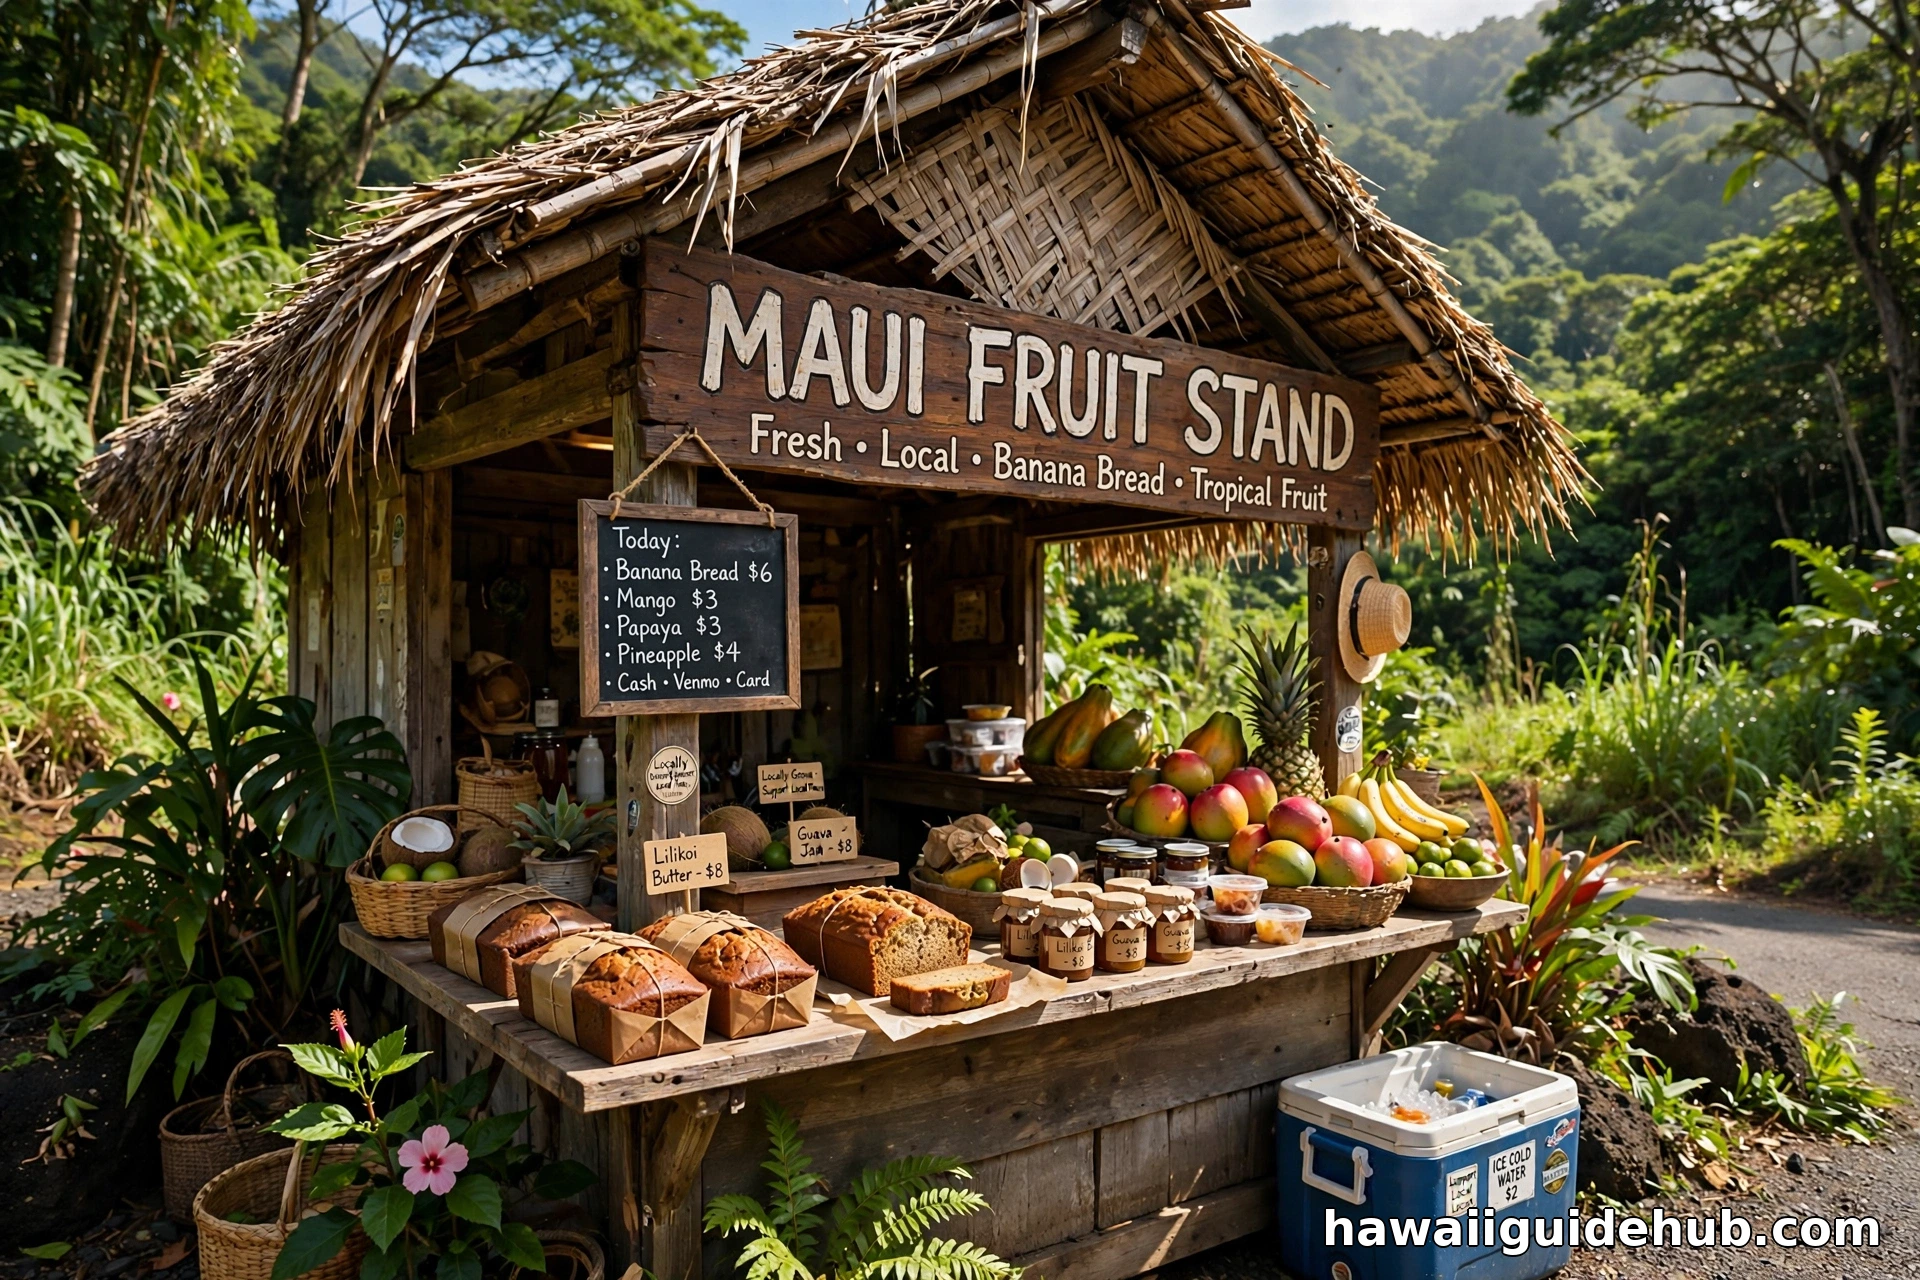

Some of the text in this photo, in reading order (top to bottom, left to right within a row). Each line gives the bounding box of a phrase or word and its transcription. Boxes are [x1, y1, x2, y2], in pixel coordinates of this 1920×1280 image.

[702, 282, 1356, 473] MAUI FRUIT STAND
[750, 413, 1328, 512] Fresh Local Banana Bread Tropical Fruit
[612, 526, 680, 558] Today:
[616, 558, 773, 582] Banana Bread $6
[616, 588, 718, 617] Mango $3
[617, 615, 722, 643] Papaya $3
[617, 641, 741, 669] Pineapple $4
[617, 669, 770, 692] Cash Venmo Card
[761, 769, 788, 782] Locally
[797, 826, 833, 841] Guava
[653, 845, 697, 865] Lilikoi
[837, 838, 853, 855] $8
[652, 868, 692, 887] Butter
[705, 862, 723, 880] $8
[1072, 955, 1085, 968] $8
[1125, 947, 1138, 960] $8
[1493, 1146, 1532, 1174] ICE COLD
[1497, 1164, 1527, 1188] WATER
[1505, 1184, 1518, 1203] $2
